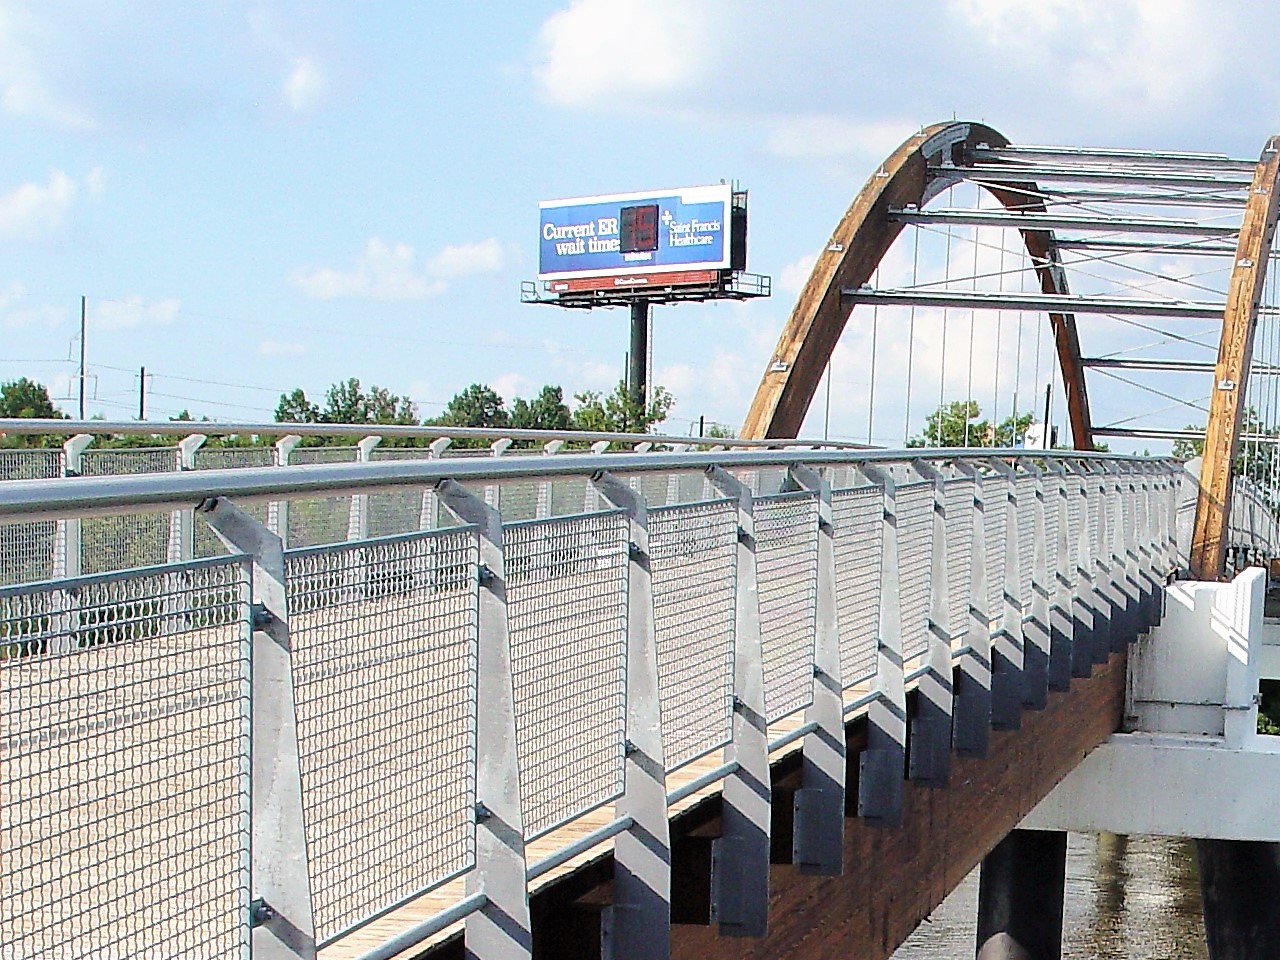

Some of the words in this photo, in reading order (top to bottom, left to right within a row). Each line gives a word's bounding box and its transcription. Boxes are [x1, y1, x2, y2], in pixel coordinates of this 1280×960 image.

[543, 221, 596, 240] Current
[597, 218, 618, 236] ER
[669, 220, 690, 234] Saint
[691, 219, 721, 233] Francis
[556, 237, 585, 256] wait
[669, 231, 714, 247] Healthcare
